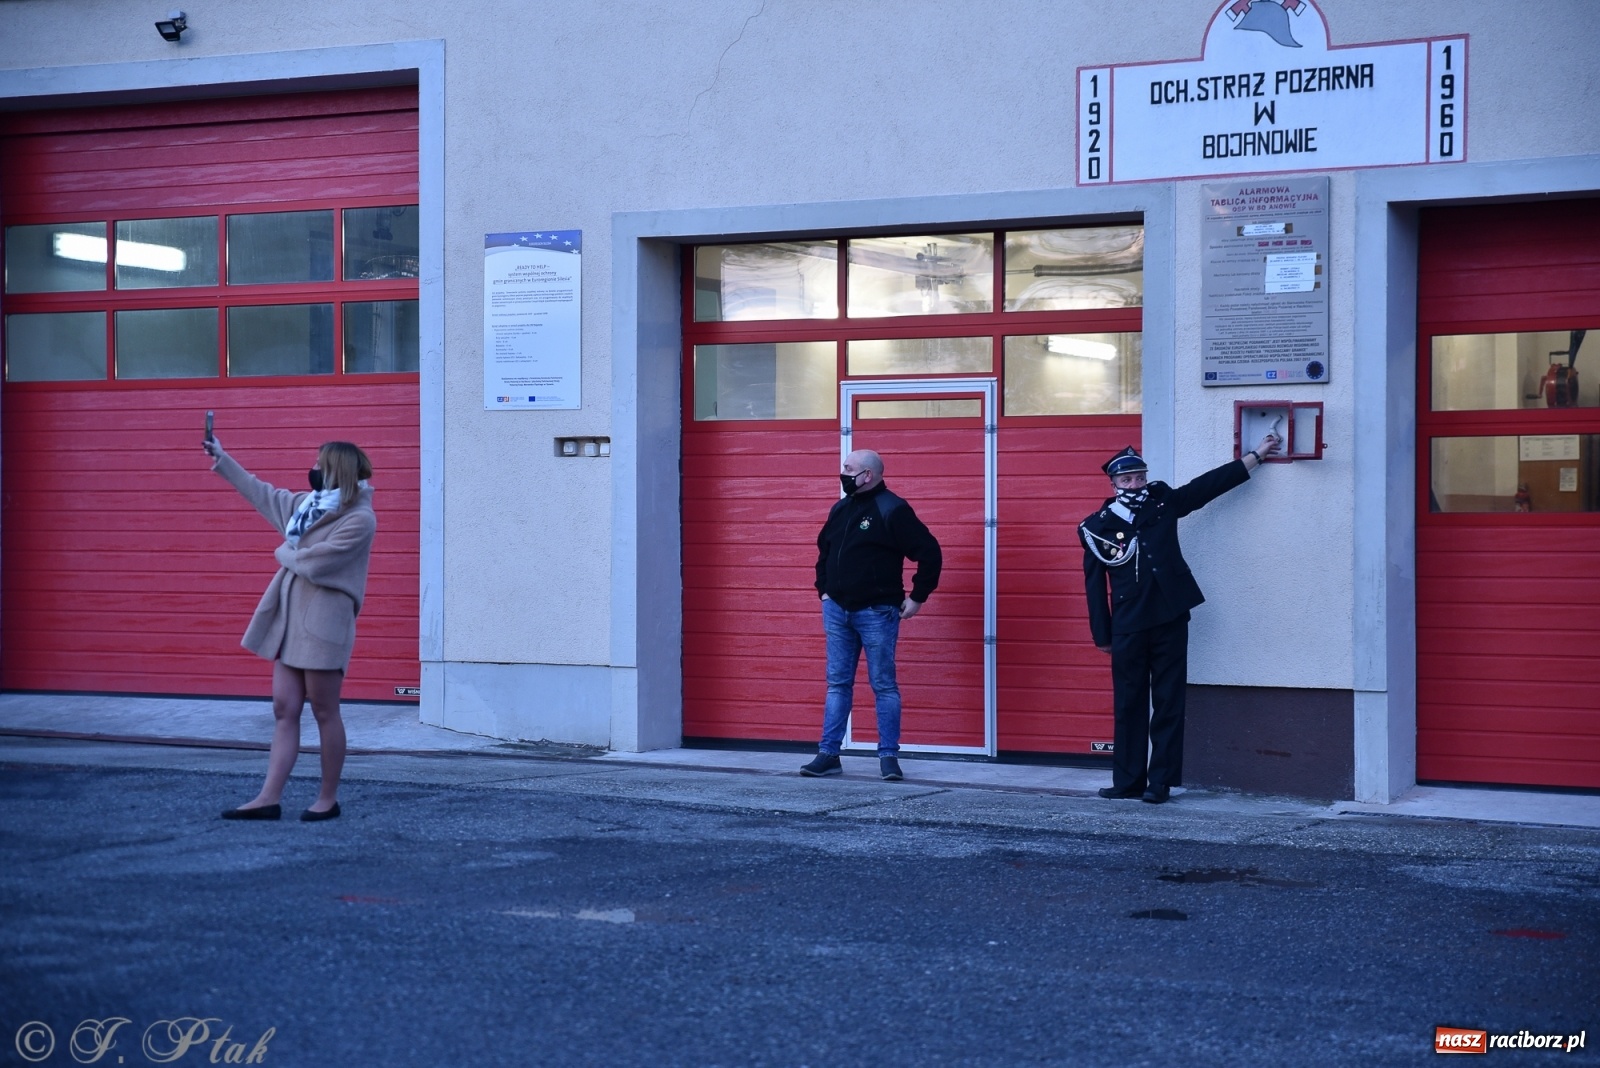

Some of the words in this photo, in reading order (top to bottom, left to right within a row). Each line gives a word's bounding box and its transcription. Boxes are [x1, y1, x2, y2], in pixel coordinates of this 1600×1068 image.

[1254, 100, 1275, 126] W
[1440, 45, 1455, 157] 1960
[1088, 74, 1101, 180] 1920
[1202, 127, 1318, 159] BOJANOWIE
[1210, 198, 1246, 207] TABLICA
[1249, 193, 1319, 204] INFORMACYJNA
[1238, 186, 1290, 196] ALARMOWA
